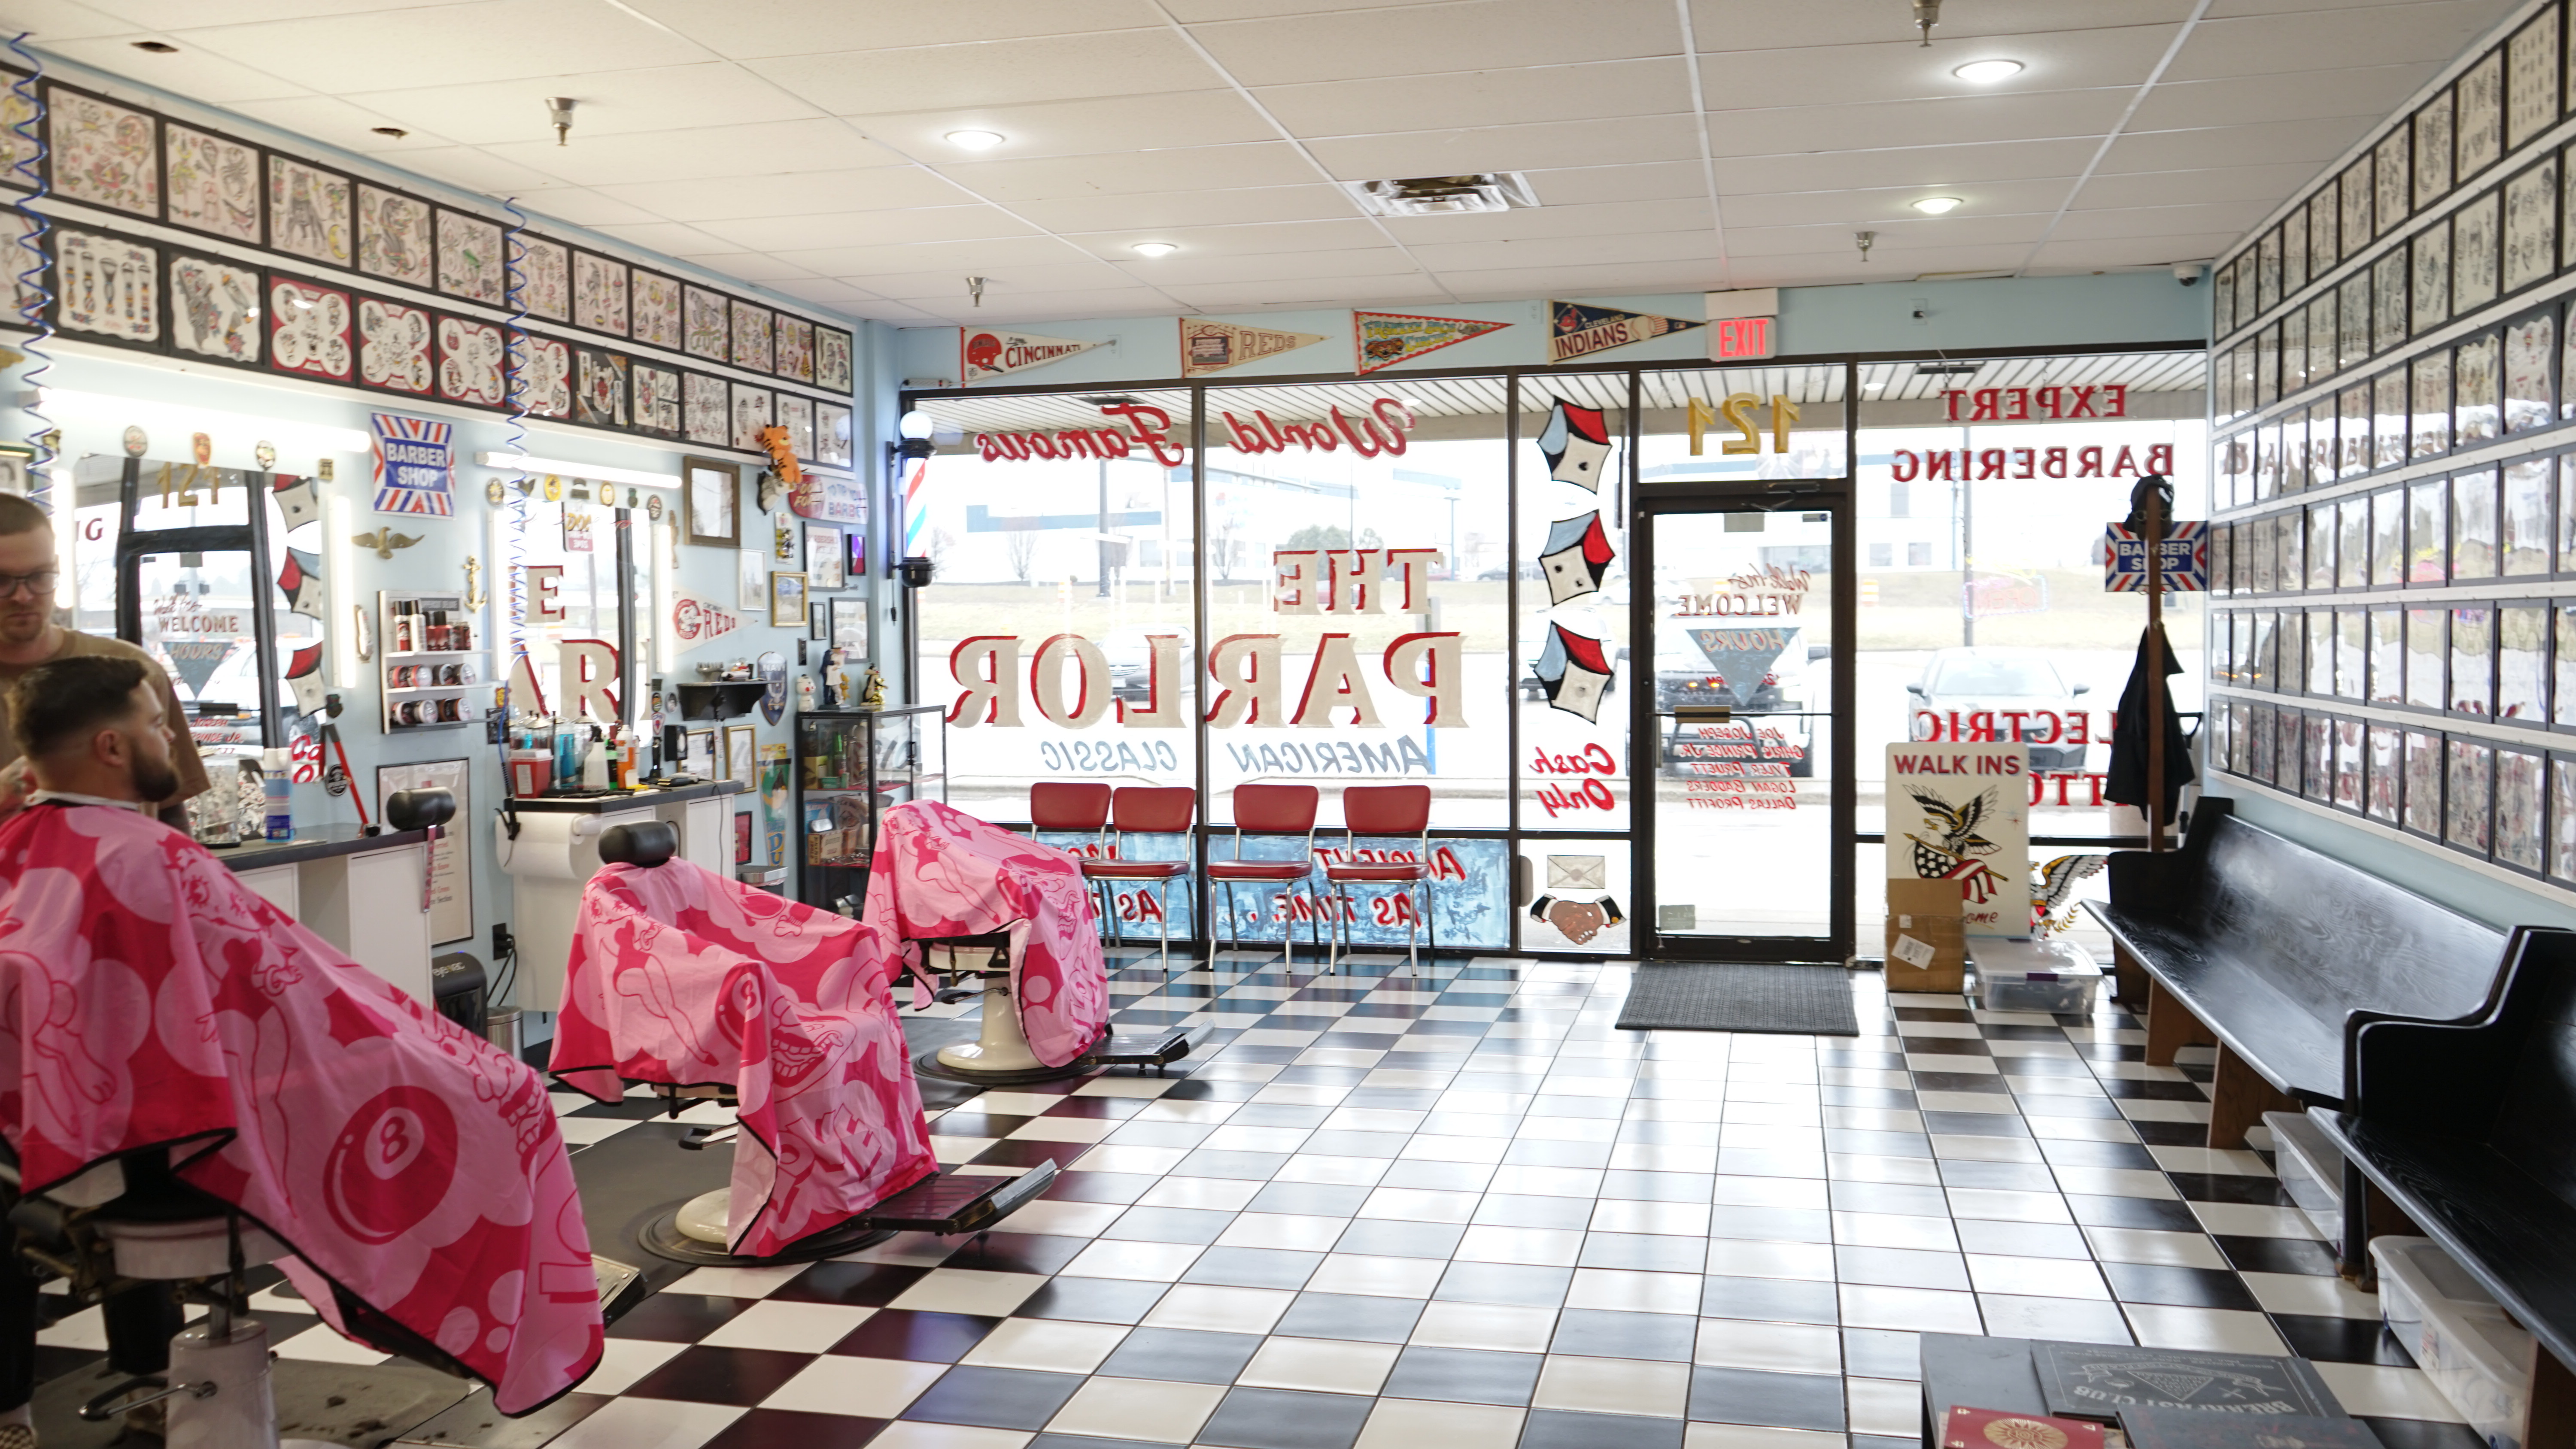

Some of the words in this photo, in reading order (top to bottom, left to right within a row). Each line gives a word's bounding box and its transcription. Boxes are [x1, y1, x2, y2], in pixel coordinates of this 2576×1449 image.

[1585, 313, 1625, 330] CLEVELAND
[1239, 330, 1297, 361] REDS
[1555, 322, 1628, 359] INDIANS
[1720, 319, 1768, 358] EXIT
[1005, 344, 1081, 368] CINCINNATI
[386, 443, 446, 467] BARBER
[397, 465, 440, 487] SHOP
[158, 615, 240, 633] WELCOME
[1893, 754, 1969, 775] WALK
[1976, 754, 2022, 775] INS
[379, 1116, 410, 1165] 8
